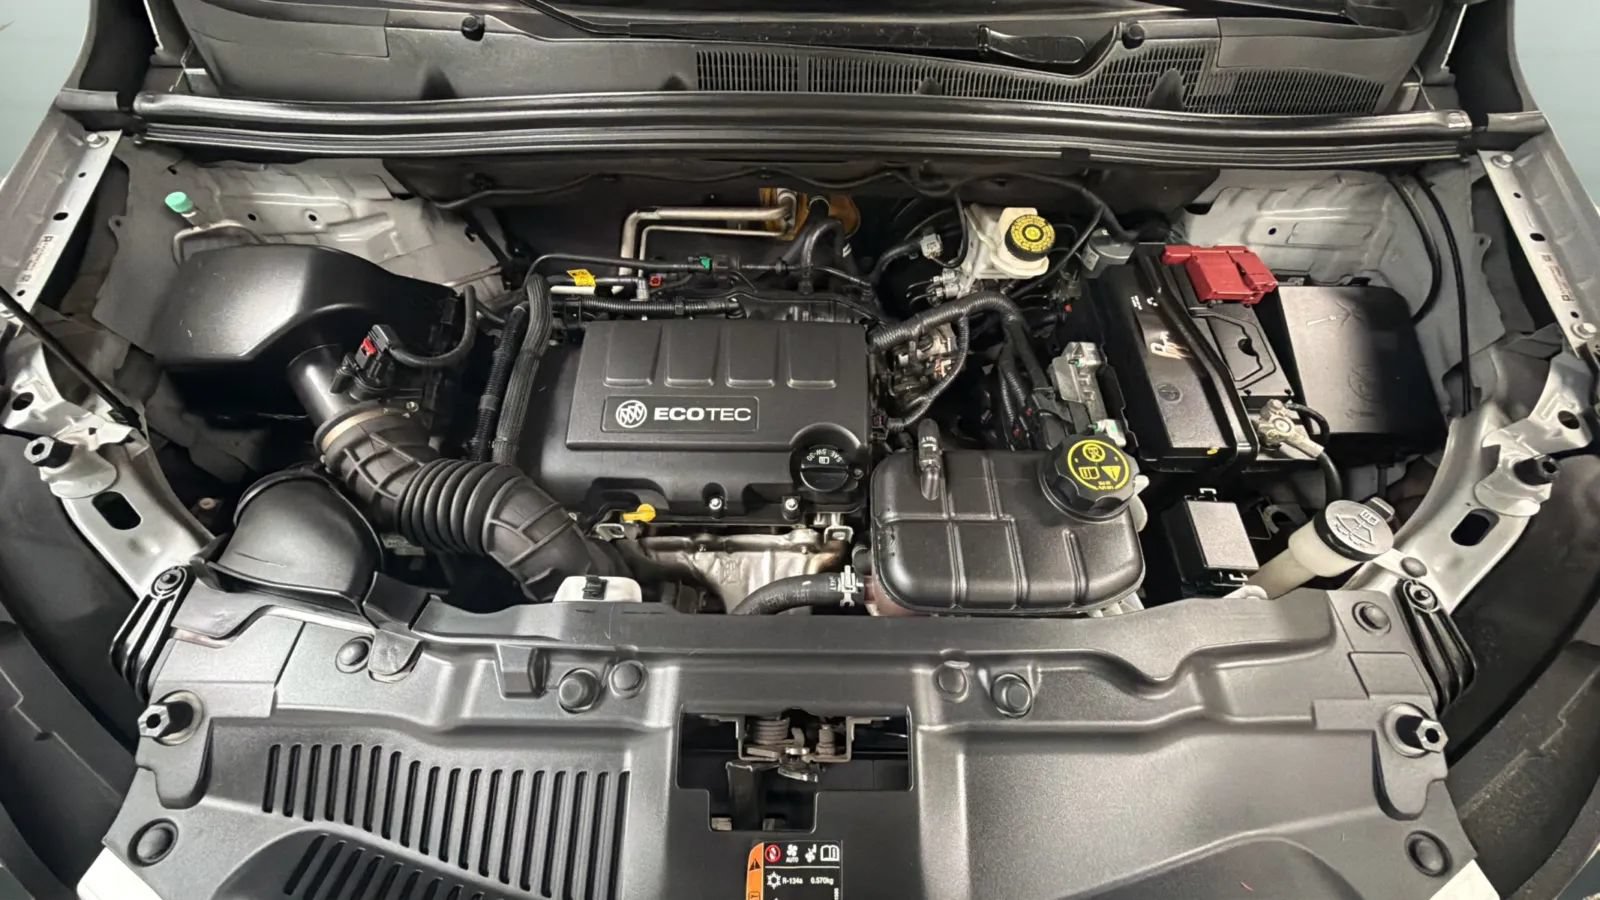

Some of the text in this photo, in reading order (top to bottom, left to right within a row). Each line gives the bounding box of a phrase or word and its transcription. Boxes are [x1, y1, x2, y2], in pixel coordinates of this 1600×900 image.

[653, 407, 751, 421] ECOTEC
[830, 450, 843, 463] SAE
[782, 876, 834, 886] R-134a 0.570kg
